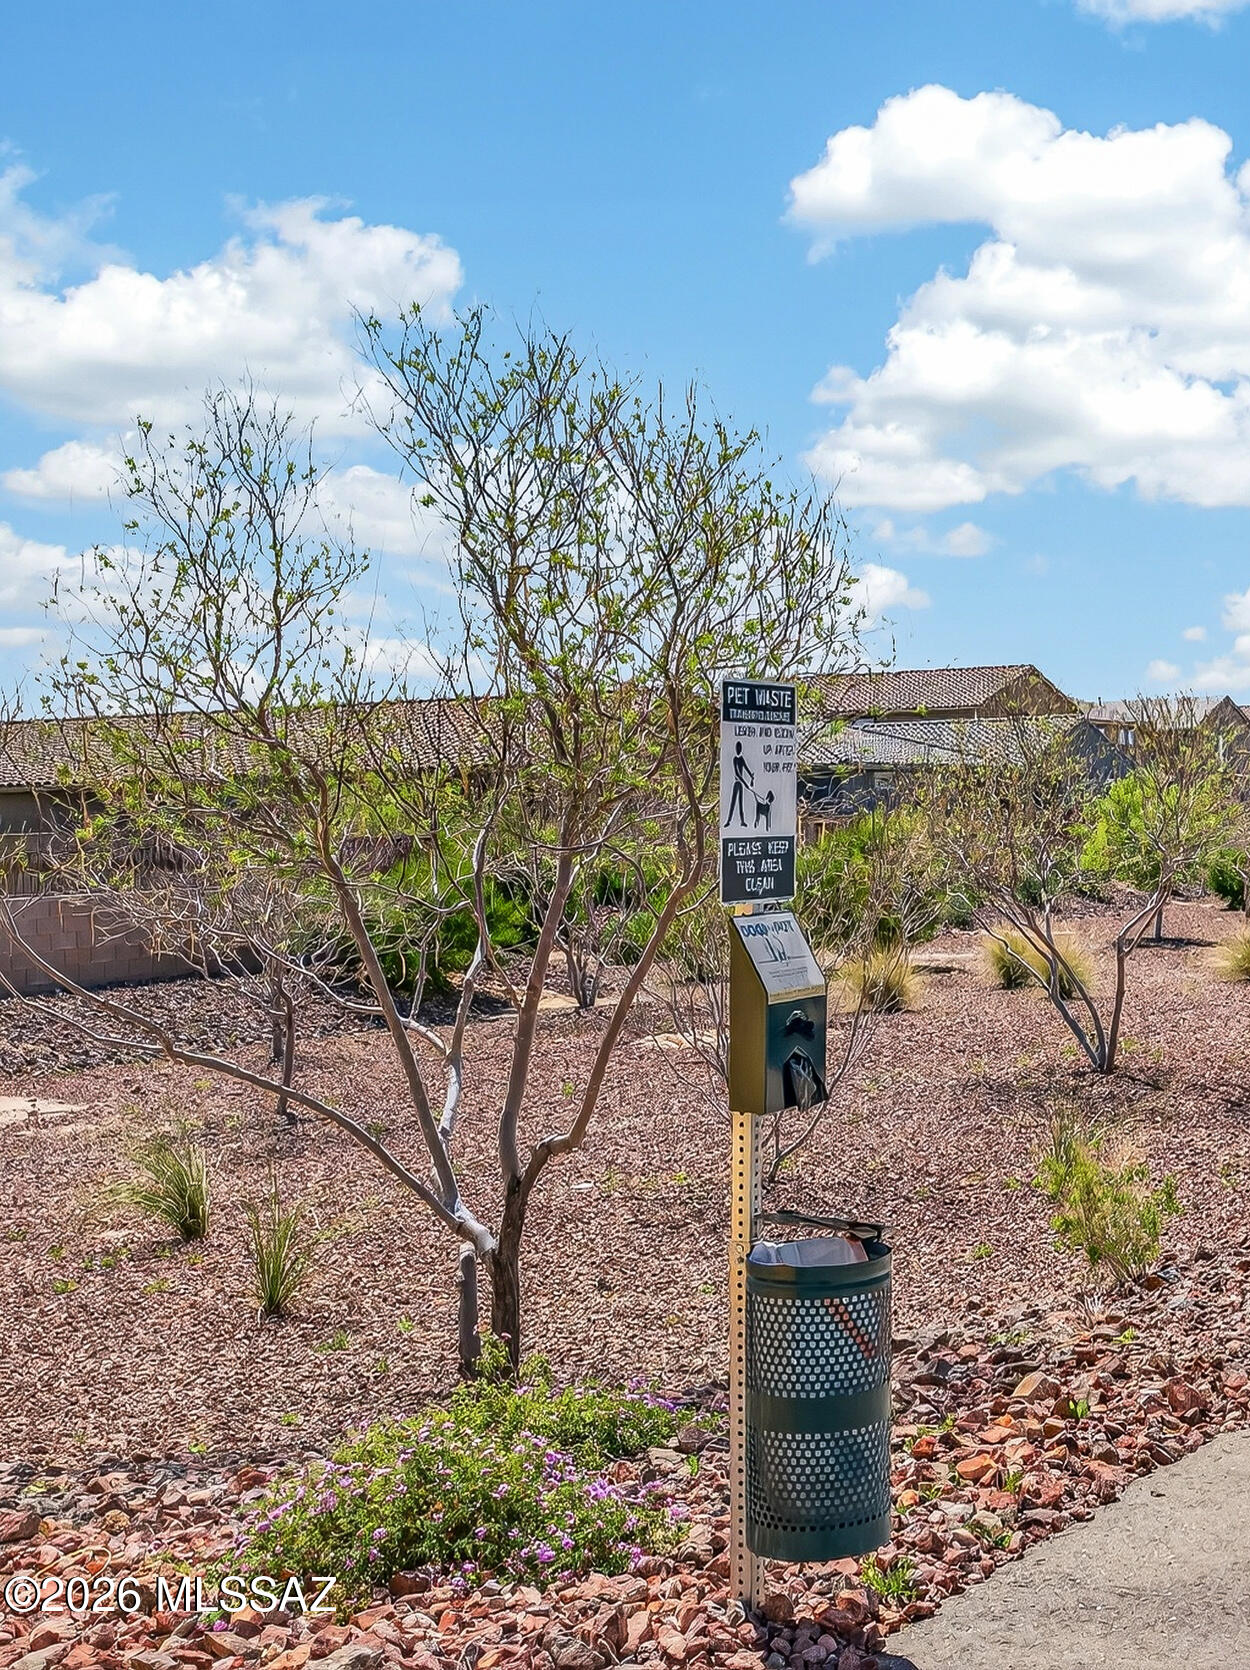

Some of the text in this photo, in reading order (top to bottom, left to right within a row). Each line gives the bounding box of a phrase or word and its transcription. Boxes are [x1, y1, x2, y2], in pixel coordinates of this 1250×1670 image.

[727, 686, 792, 708] PET WASTE
[728, 840, 789, 857] PLEASE KEEP
[736, 858, 783, 874] THIS AREA
[745, 877, 774, 893] CLEAN
